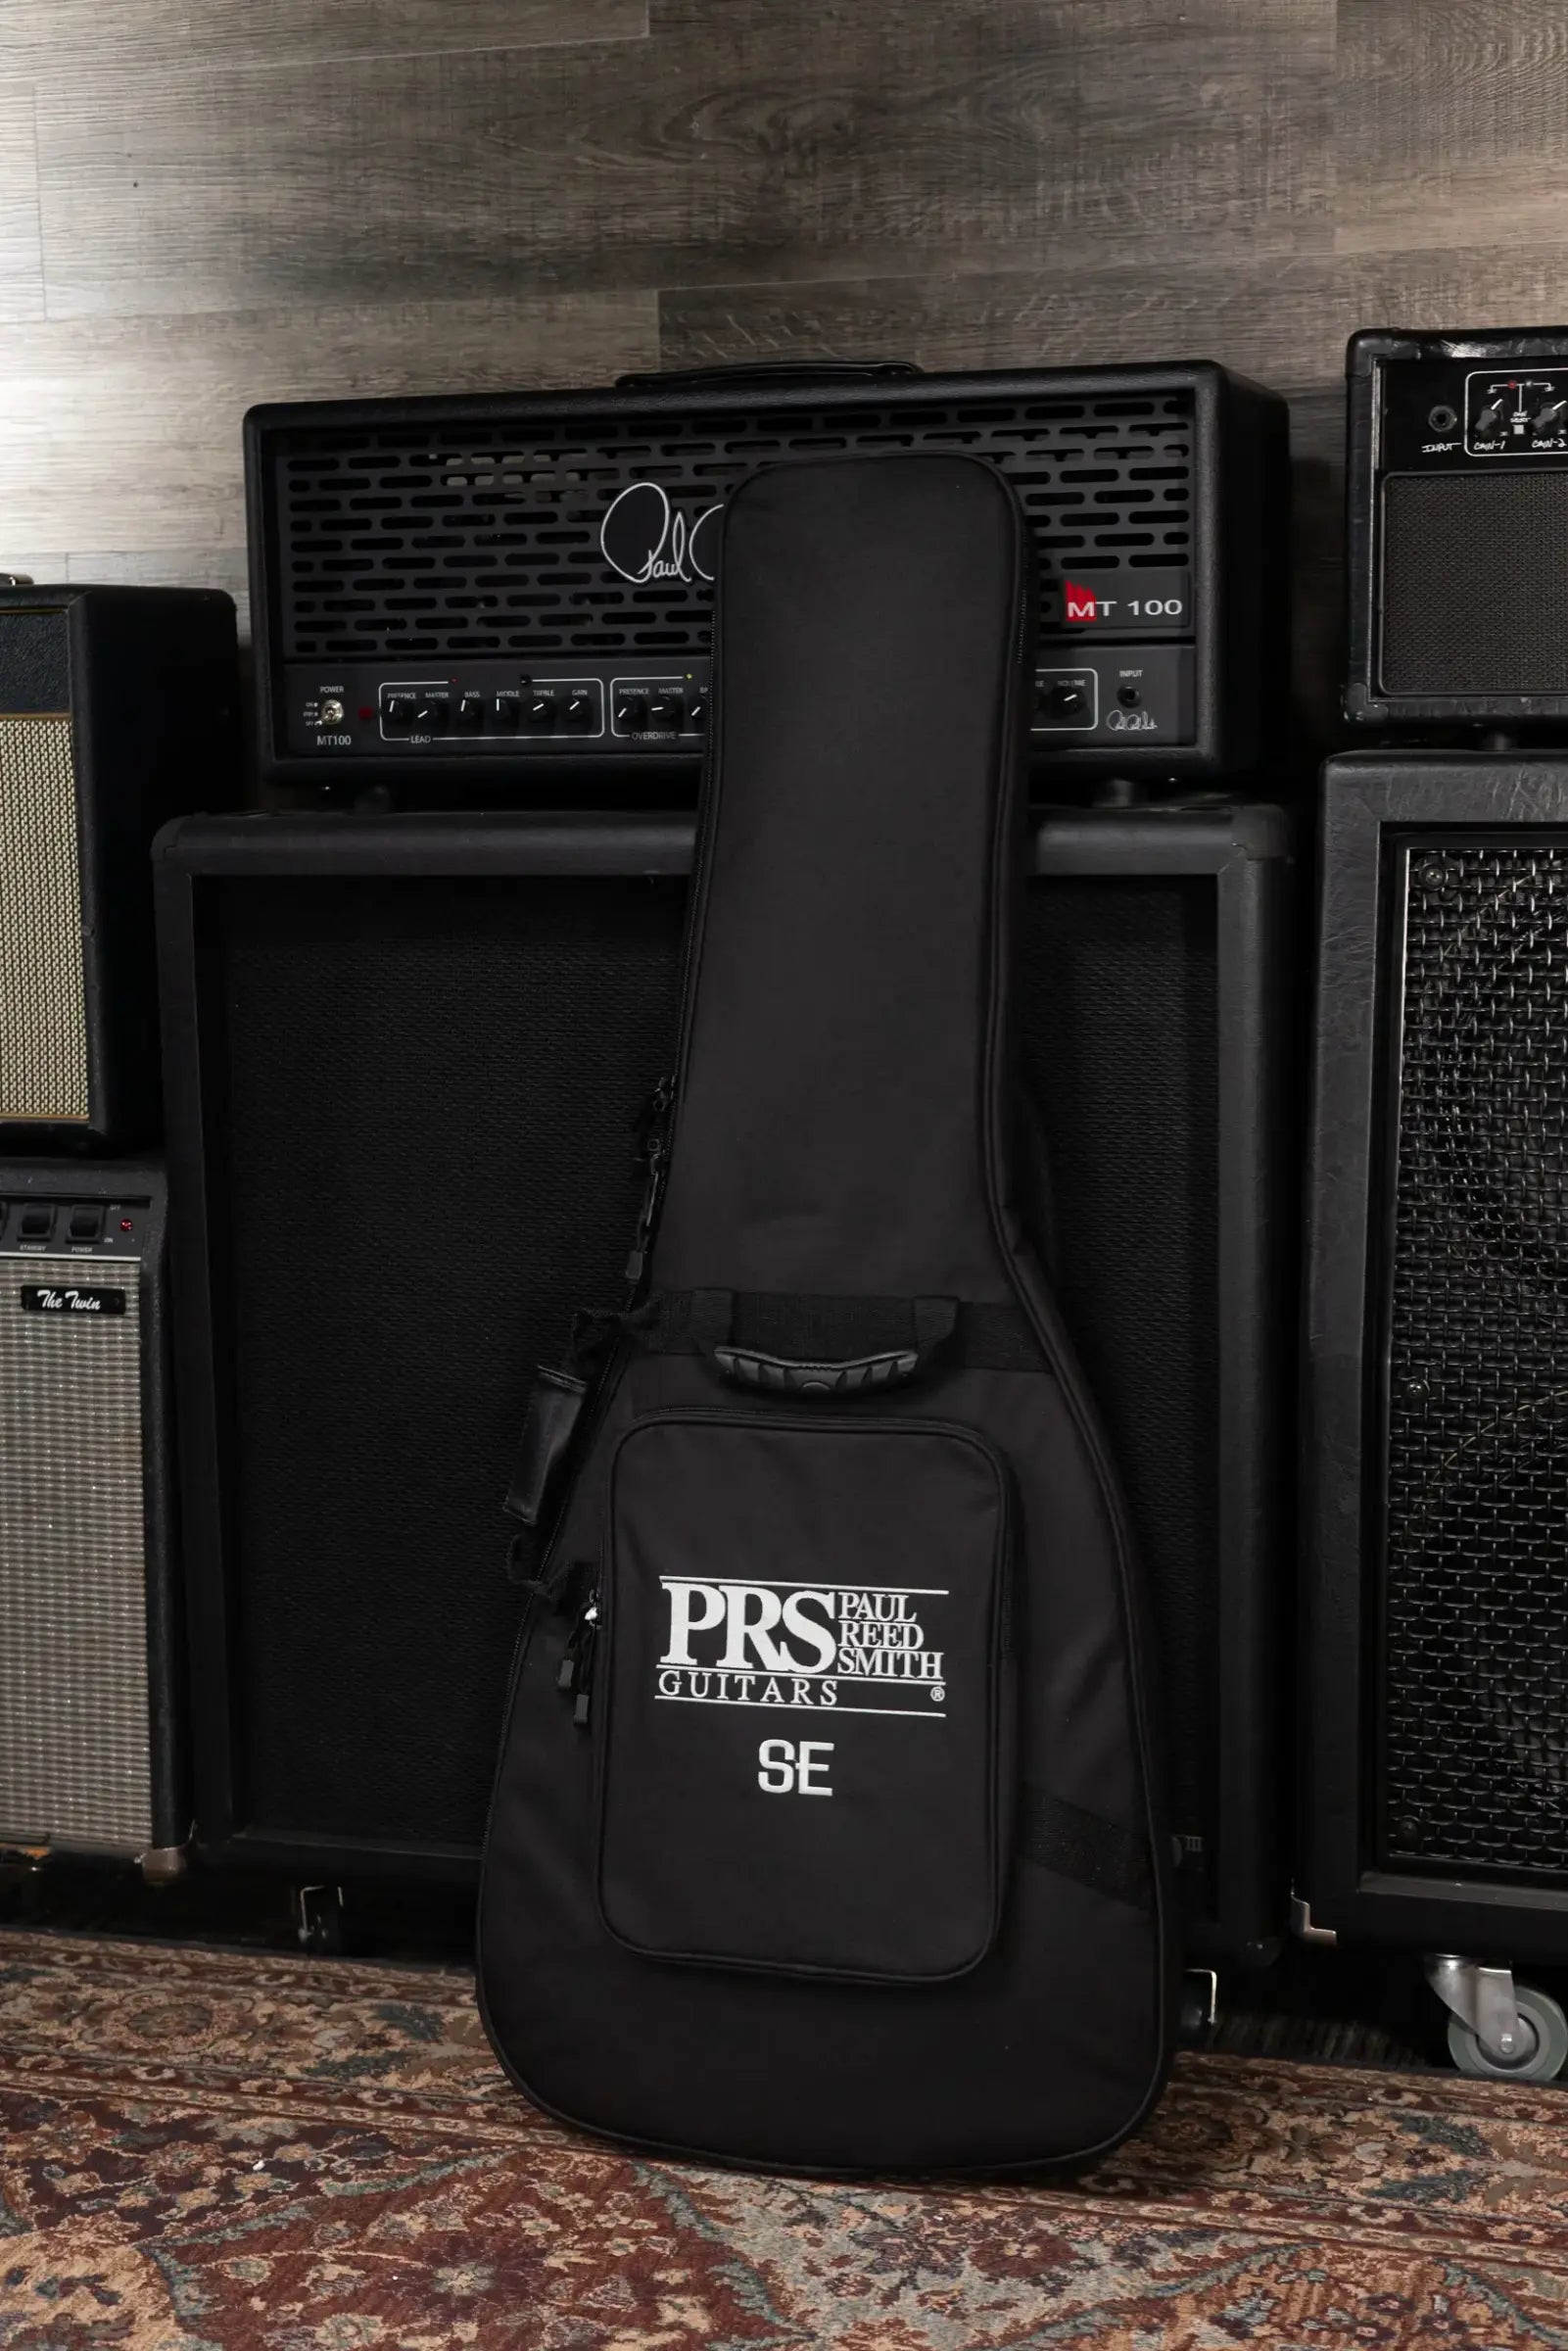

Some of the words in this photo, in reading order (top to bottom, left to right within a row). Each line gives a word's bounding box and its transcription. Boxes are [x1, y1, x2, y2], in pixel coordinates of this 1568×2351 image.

[1421, 443, 1462, 454] INPUT
[1532, 437, 1567, 449] GAIN-2
[1068, 600, 1117, 618] MT
[1127, 599, 1183, 616] 100
[1119, 669, 1144, 678] INPUT
[316, 735, 353, 745] MT100
[631, 732, 678, 741] OVERDRIVE
[36, 1289, 64, 1310] The
[64, 1290, 102, 1311] Twin
[836, 1591, 918, 1623] PAUL
[659, 1581, 836, 1675] PRS
[836, 1619, 926, 1651] REED
[836, 1647, 945, 1680] SMITH
[657, 1668, 838, 1706] GUITARS
[757, 1738, 834, 1797] SE
